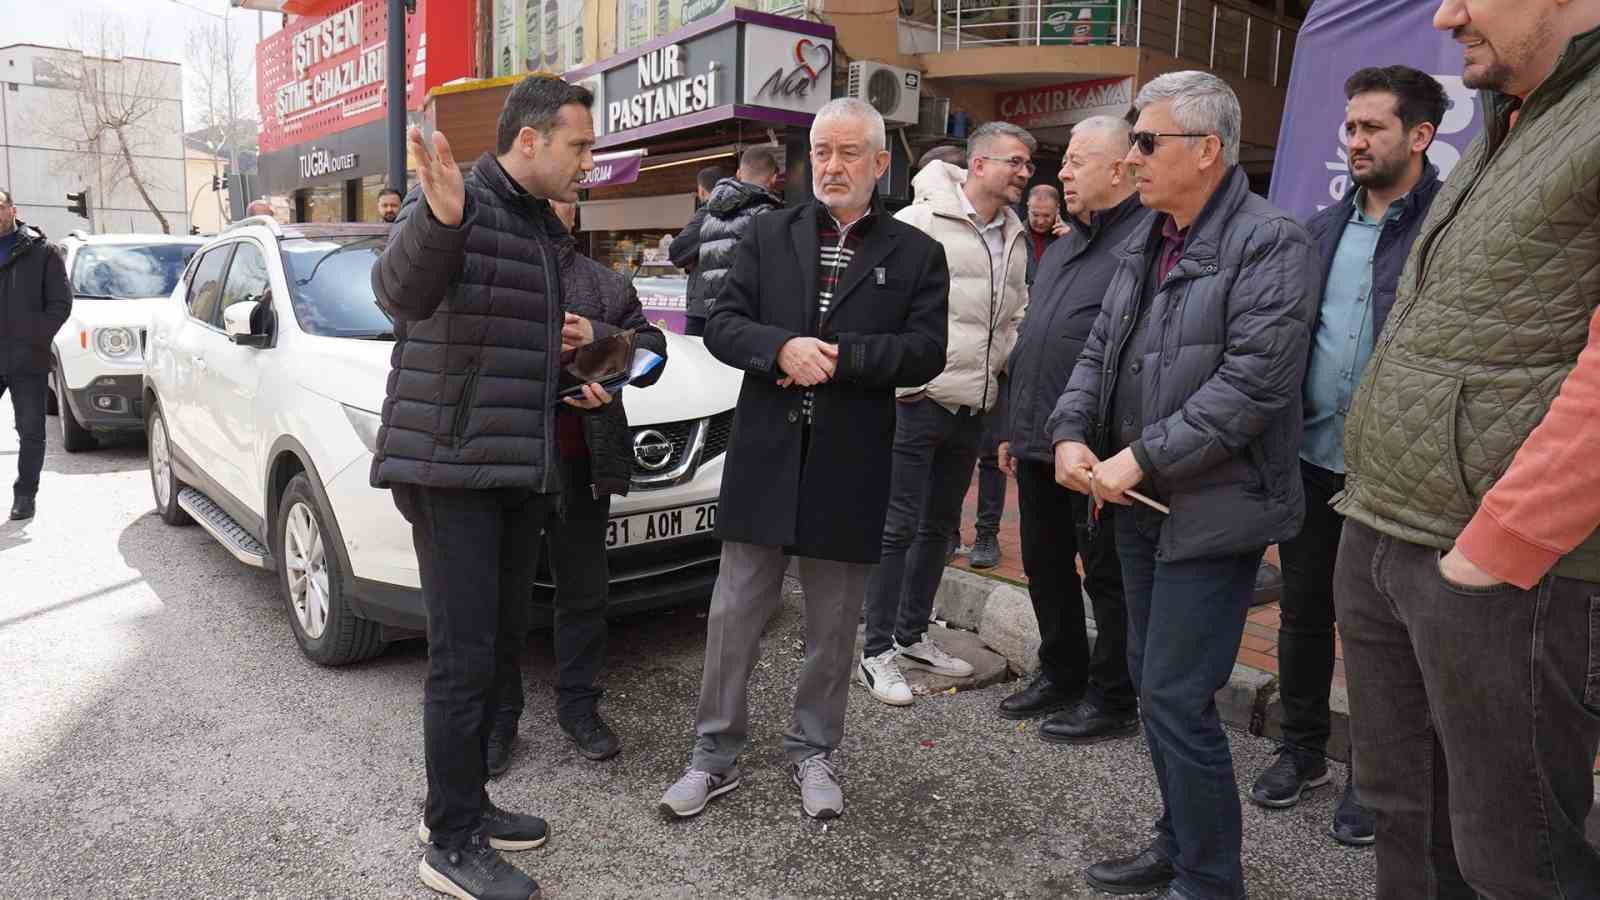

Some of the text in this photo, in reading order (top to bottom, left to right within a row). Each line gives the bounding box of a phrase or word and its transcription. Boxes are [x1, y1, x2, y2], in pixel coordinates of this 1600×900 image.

[637, 44, 682, 89] NUR
[609, 60, 718, 133] PASTANESİ
[299, 146, 355, 178] TUĞBA OUTLET
[606, 519, 630, 546] 31
[646, 510, 682, 540] AOM
